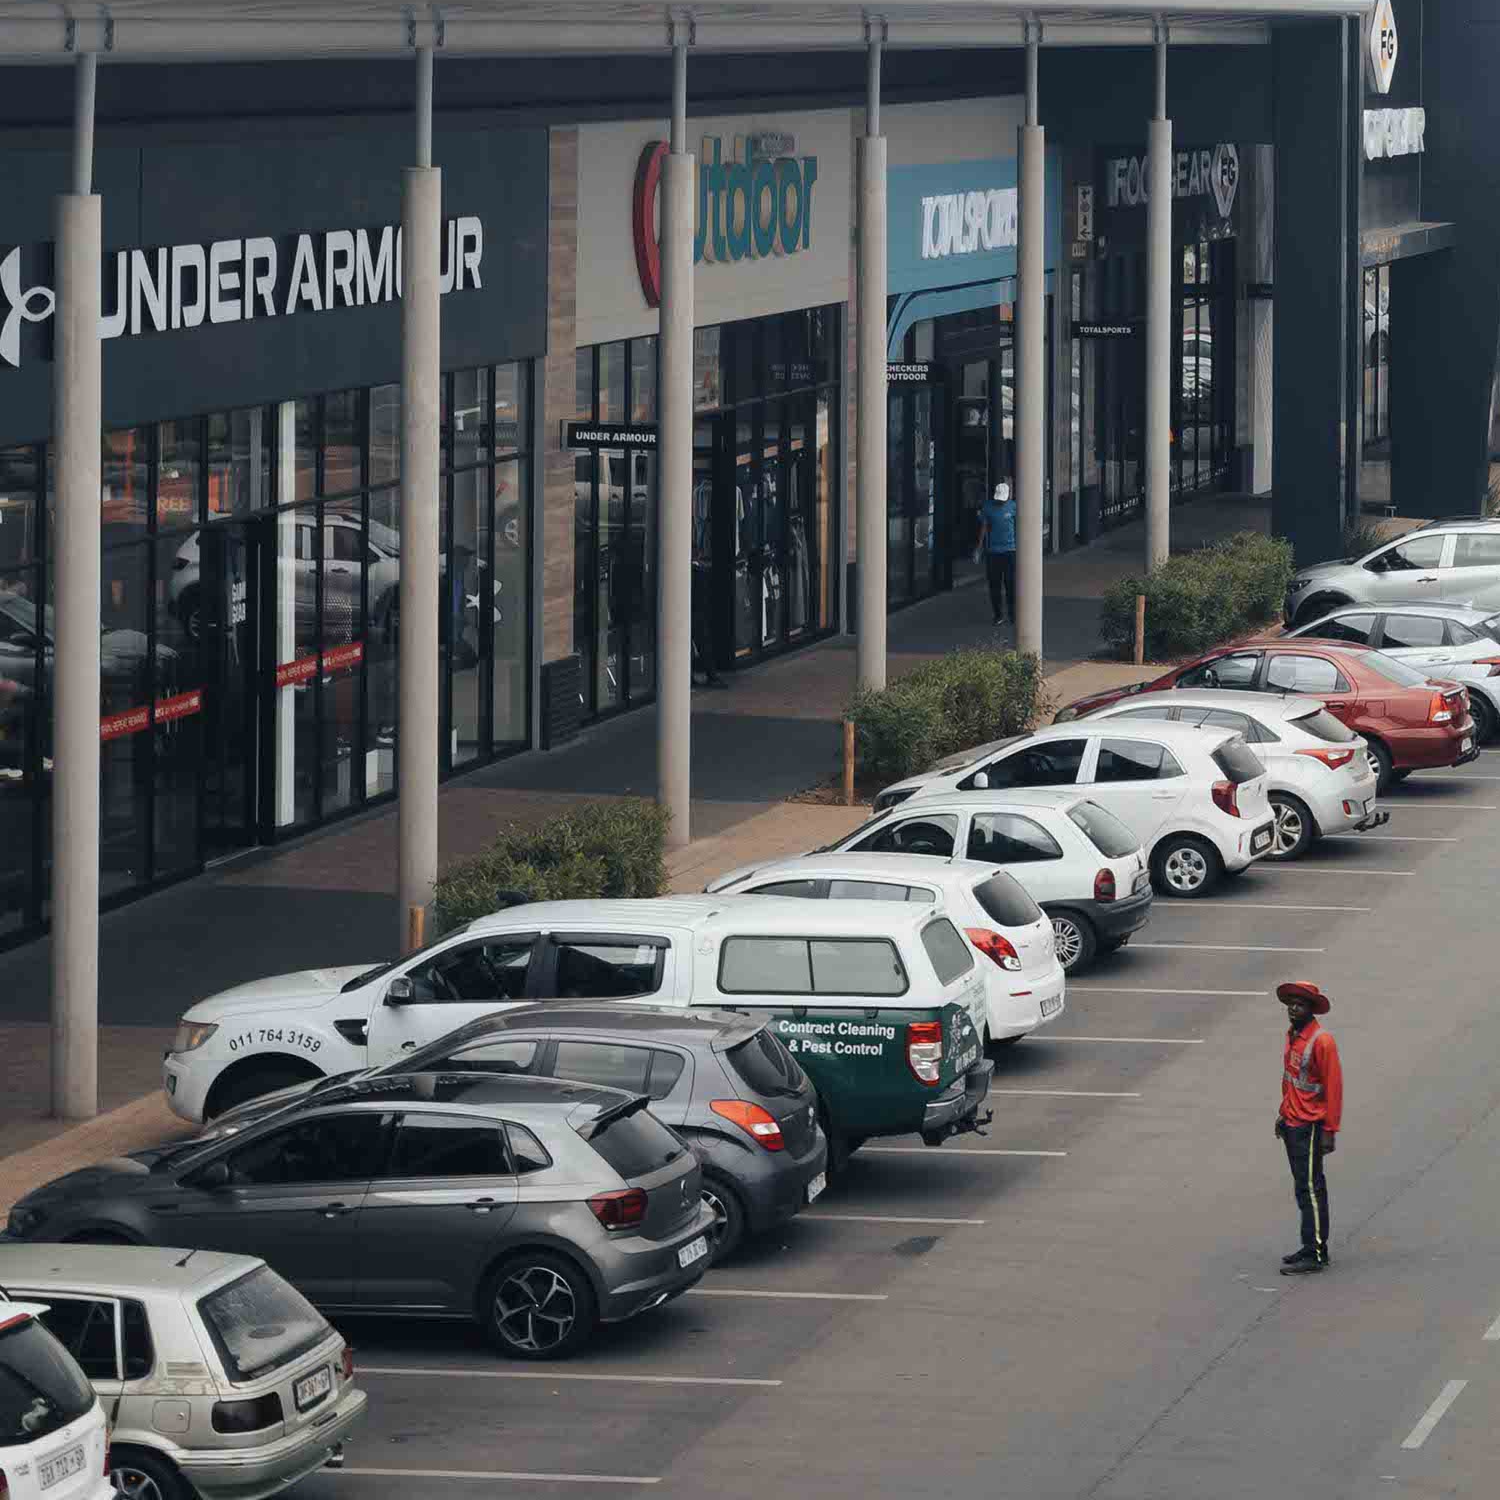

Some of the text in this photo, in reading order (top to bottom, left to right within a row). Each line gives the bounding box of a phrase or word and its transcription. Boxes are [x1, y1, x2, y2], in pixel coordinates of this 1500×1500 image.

[96, 216, 483, 340] UNDER ARMUR
[1079, 326, 1131, 334] TOTALSPORTS
[886, 372, 927, 381] OUTDOOR
[576, 431, 656, 443] UNDER ARMOUR
[779, 1020, 896, 1040] Contract Cleaning
[229, 1029, 321, 1052] 011 764 3159
[788, 1039, 883, 1056] & Pest Control
